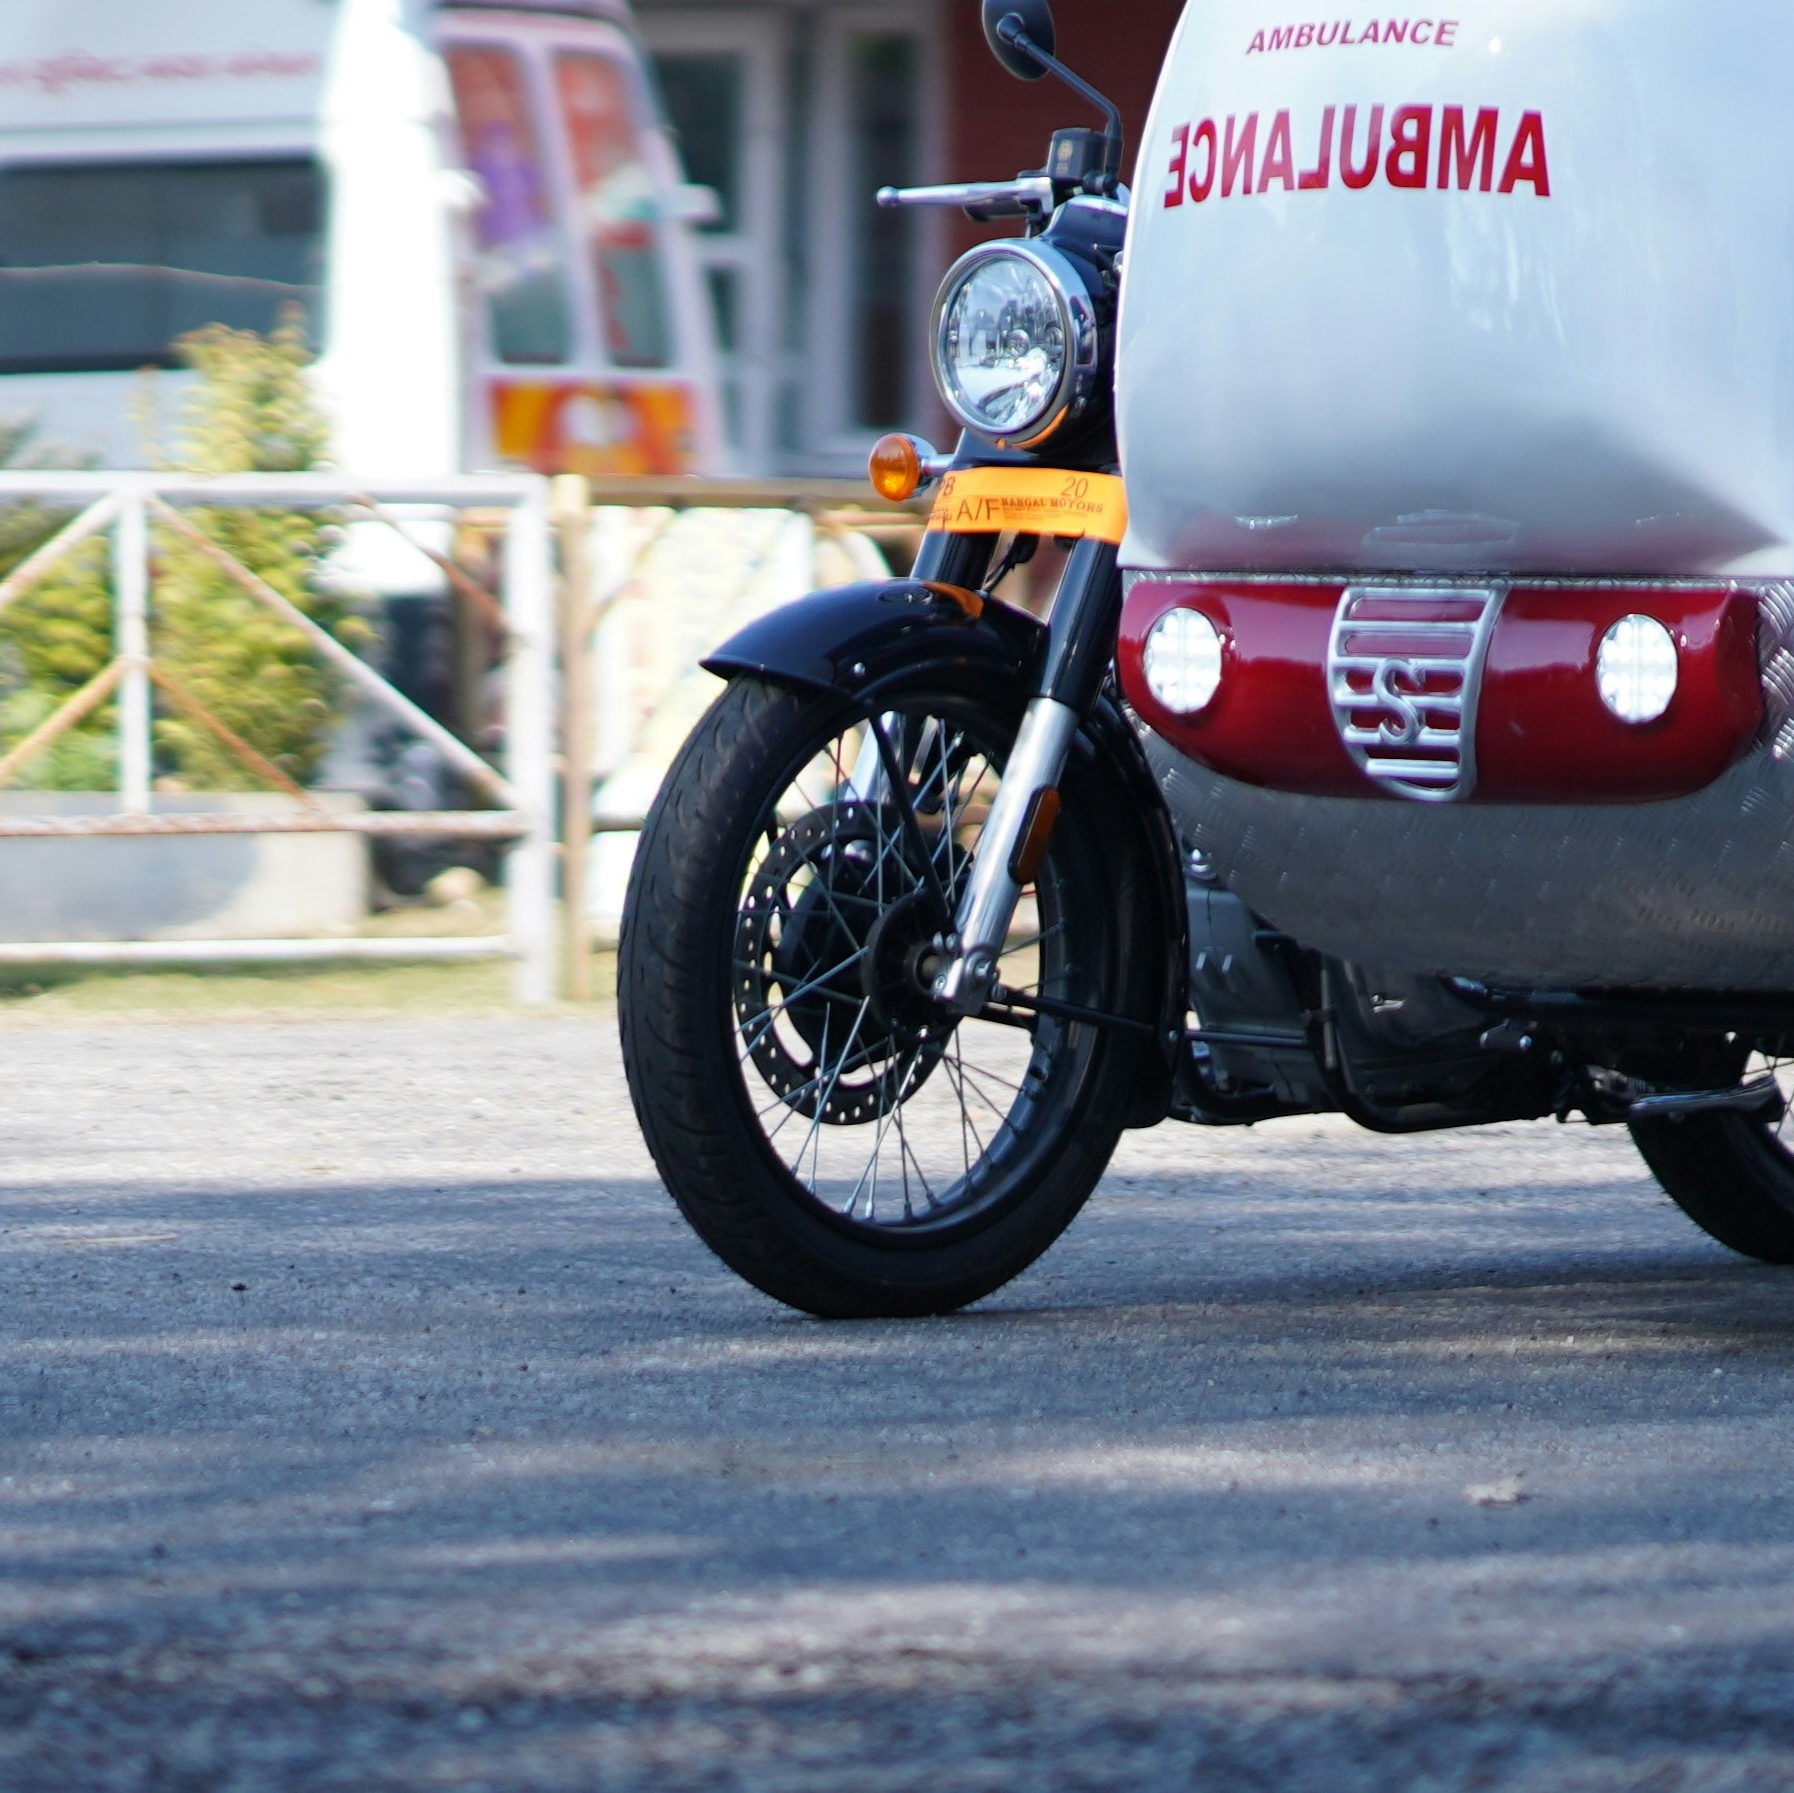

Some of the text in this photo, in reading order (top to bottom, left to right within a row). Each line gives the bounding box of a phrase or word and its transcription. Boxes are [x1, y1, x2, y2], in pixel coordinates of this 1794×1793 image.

[1247, 18, 1460, 54] AMBULANCE
[1061, 475, 1089, 499] 20
[957, 498, 1001, 522] A/F
[1050, 497, 1104, 513] MOTORS
